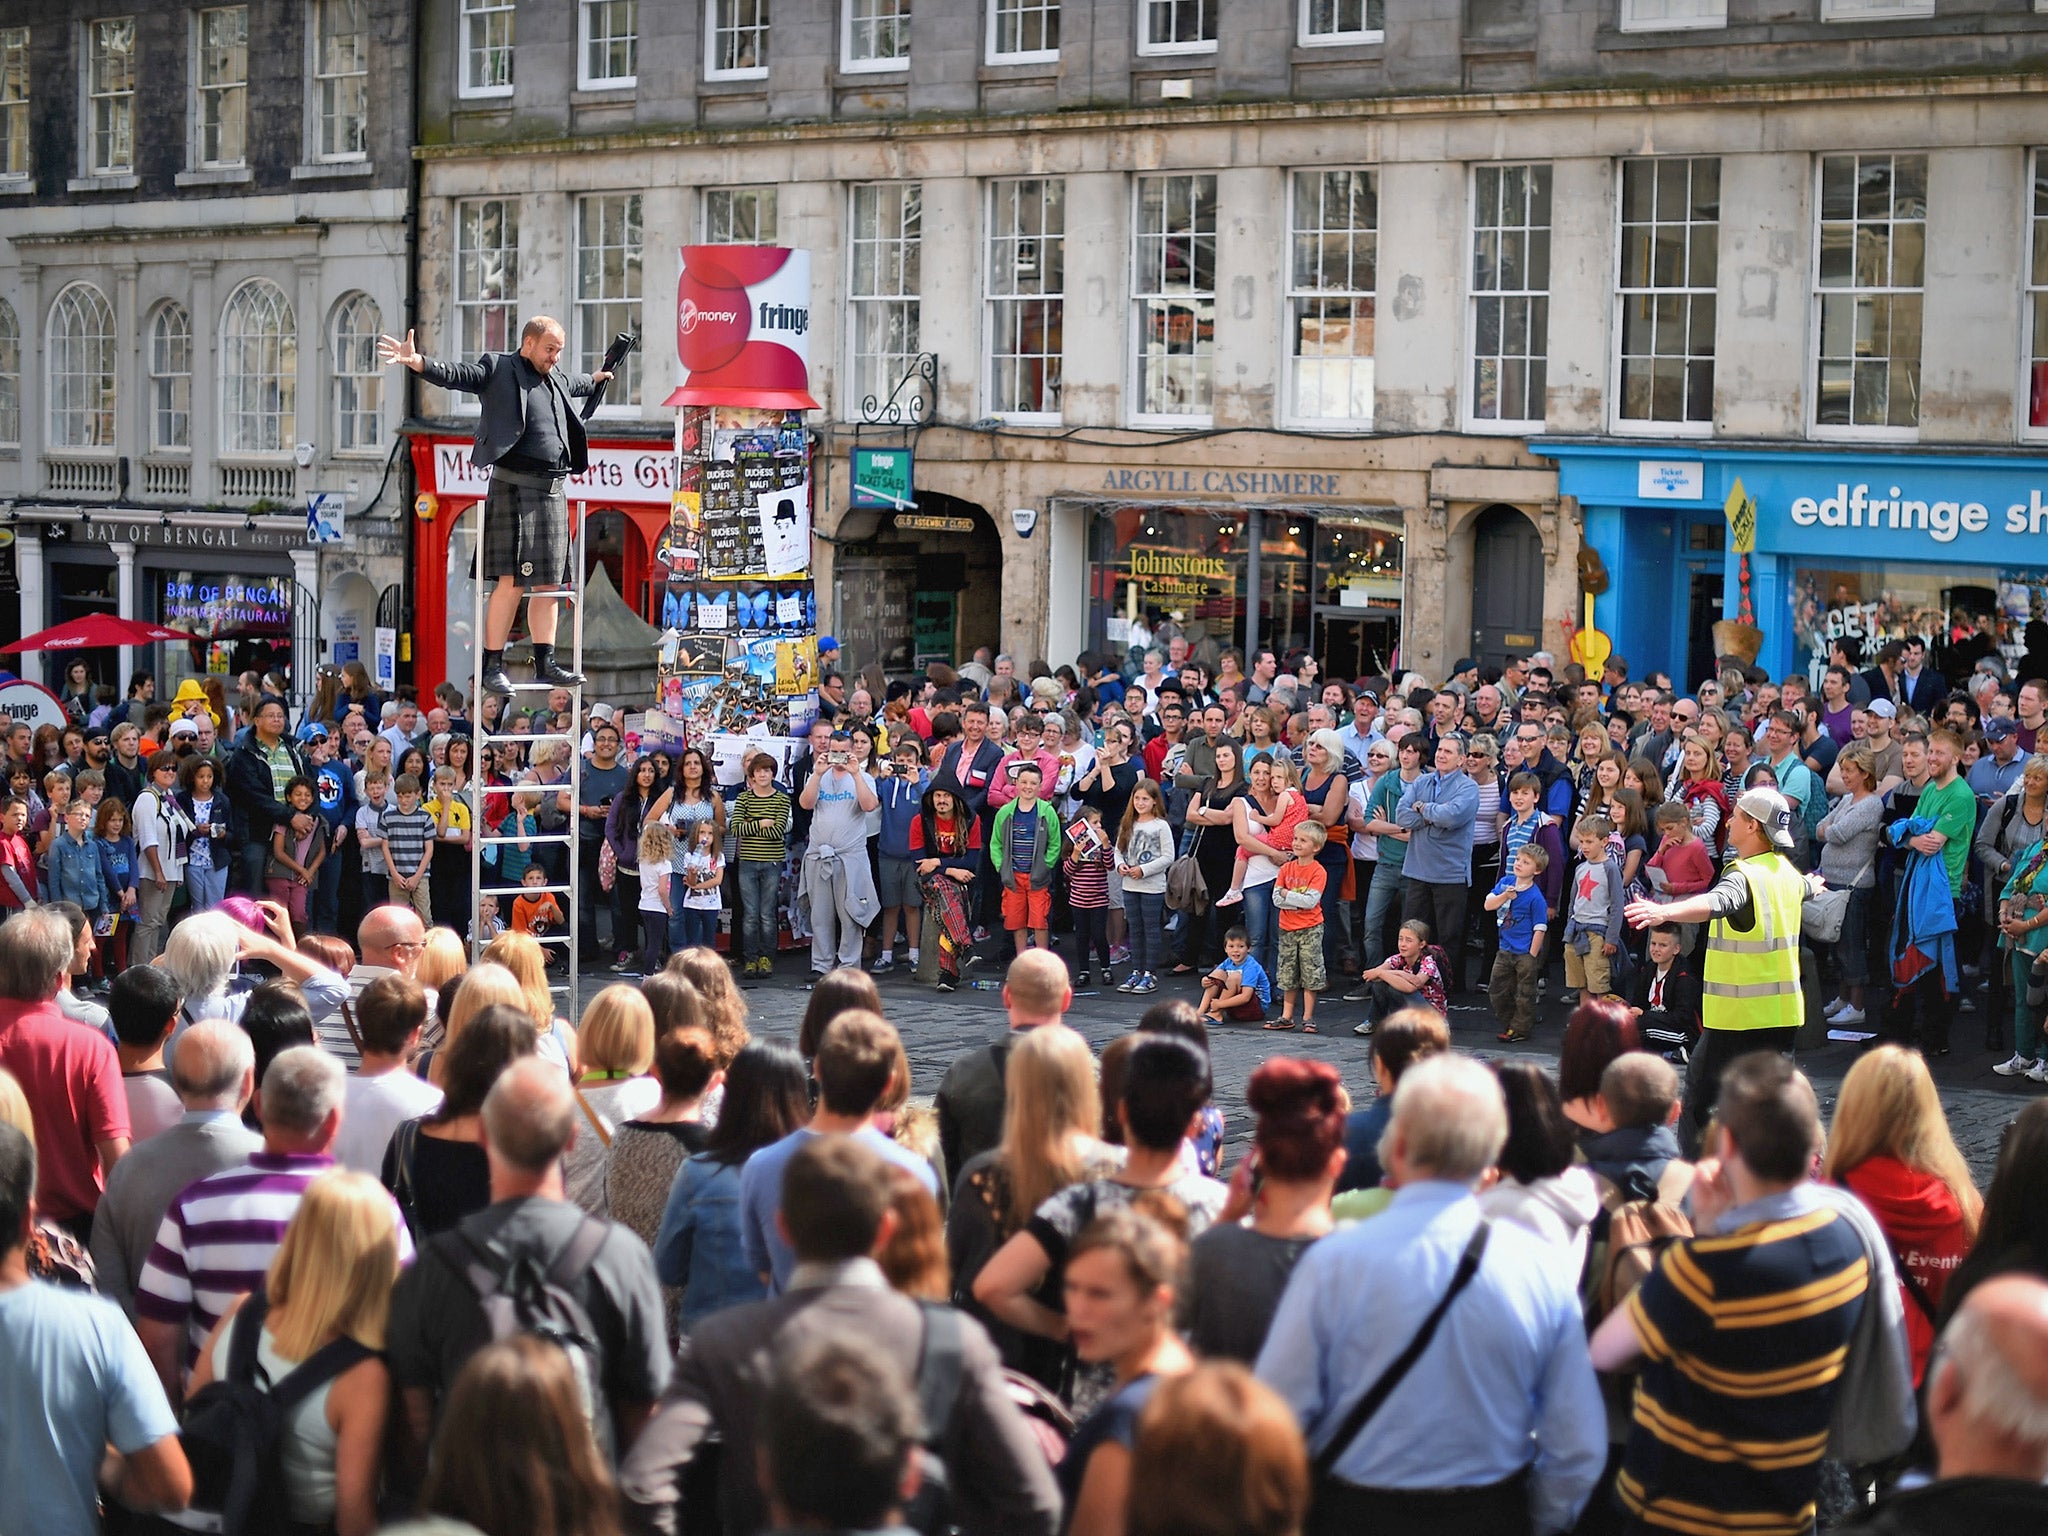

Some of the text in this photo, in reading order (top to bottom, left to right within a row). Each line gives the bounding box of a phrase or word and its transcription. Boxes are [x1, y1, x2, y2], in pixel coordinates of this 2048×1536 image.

[697, 311, 737, 325] money
[759, 302, 808, 335] fringe
[707, 469, 735, 479] DUCHESS
[745, 468, 774, 478] DUCHESS
[1102, 469, 1341, 495] ARGYLL CASHMERE
[1791, 483, 1989, 542] edfringe
[711, 526, 740, 537] DUCHESS
[899, 517, 971, 529] OLD ASSEMBLY CLOSE
[86, 523, 118, 541] BAY
[128, 524, 150, 543] OF
[163, 526, 238, 547] BENGAL
[1129, 549, 1225, 579] Johnstons
[166, 582, 286, 608] BAY OF BENGAL
[1142, 577, 1208, 595] Cashmere
[166, 603, 287, 623] INDIAN RESTAURANT
[1827, 602, 1878, 639] GET
[1, 702, 39, 721] fringe
